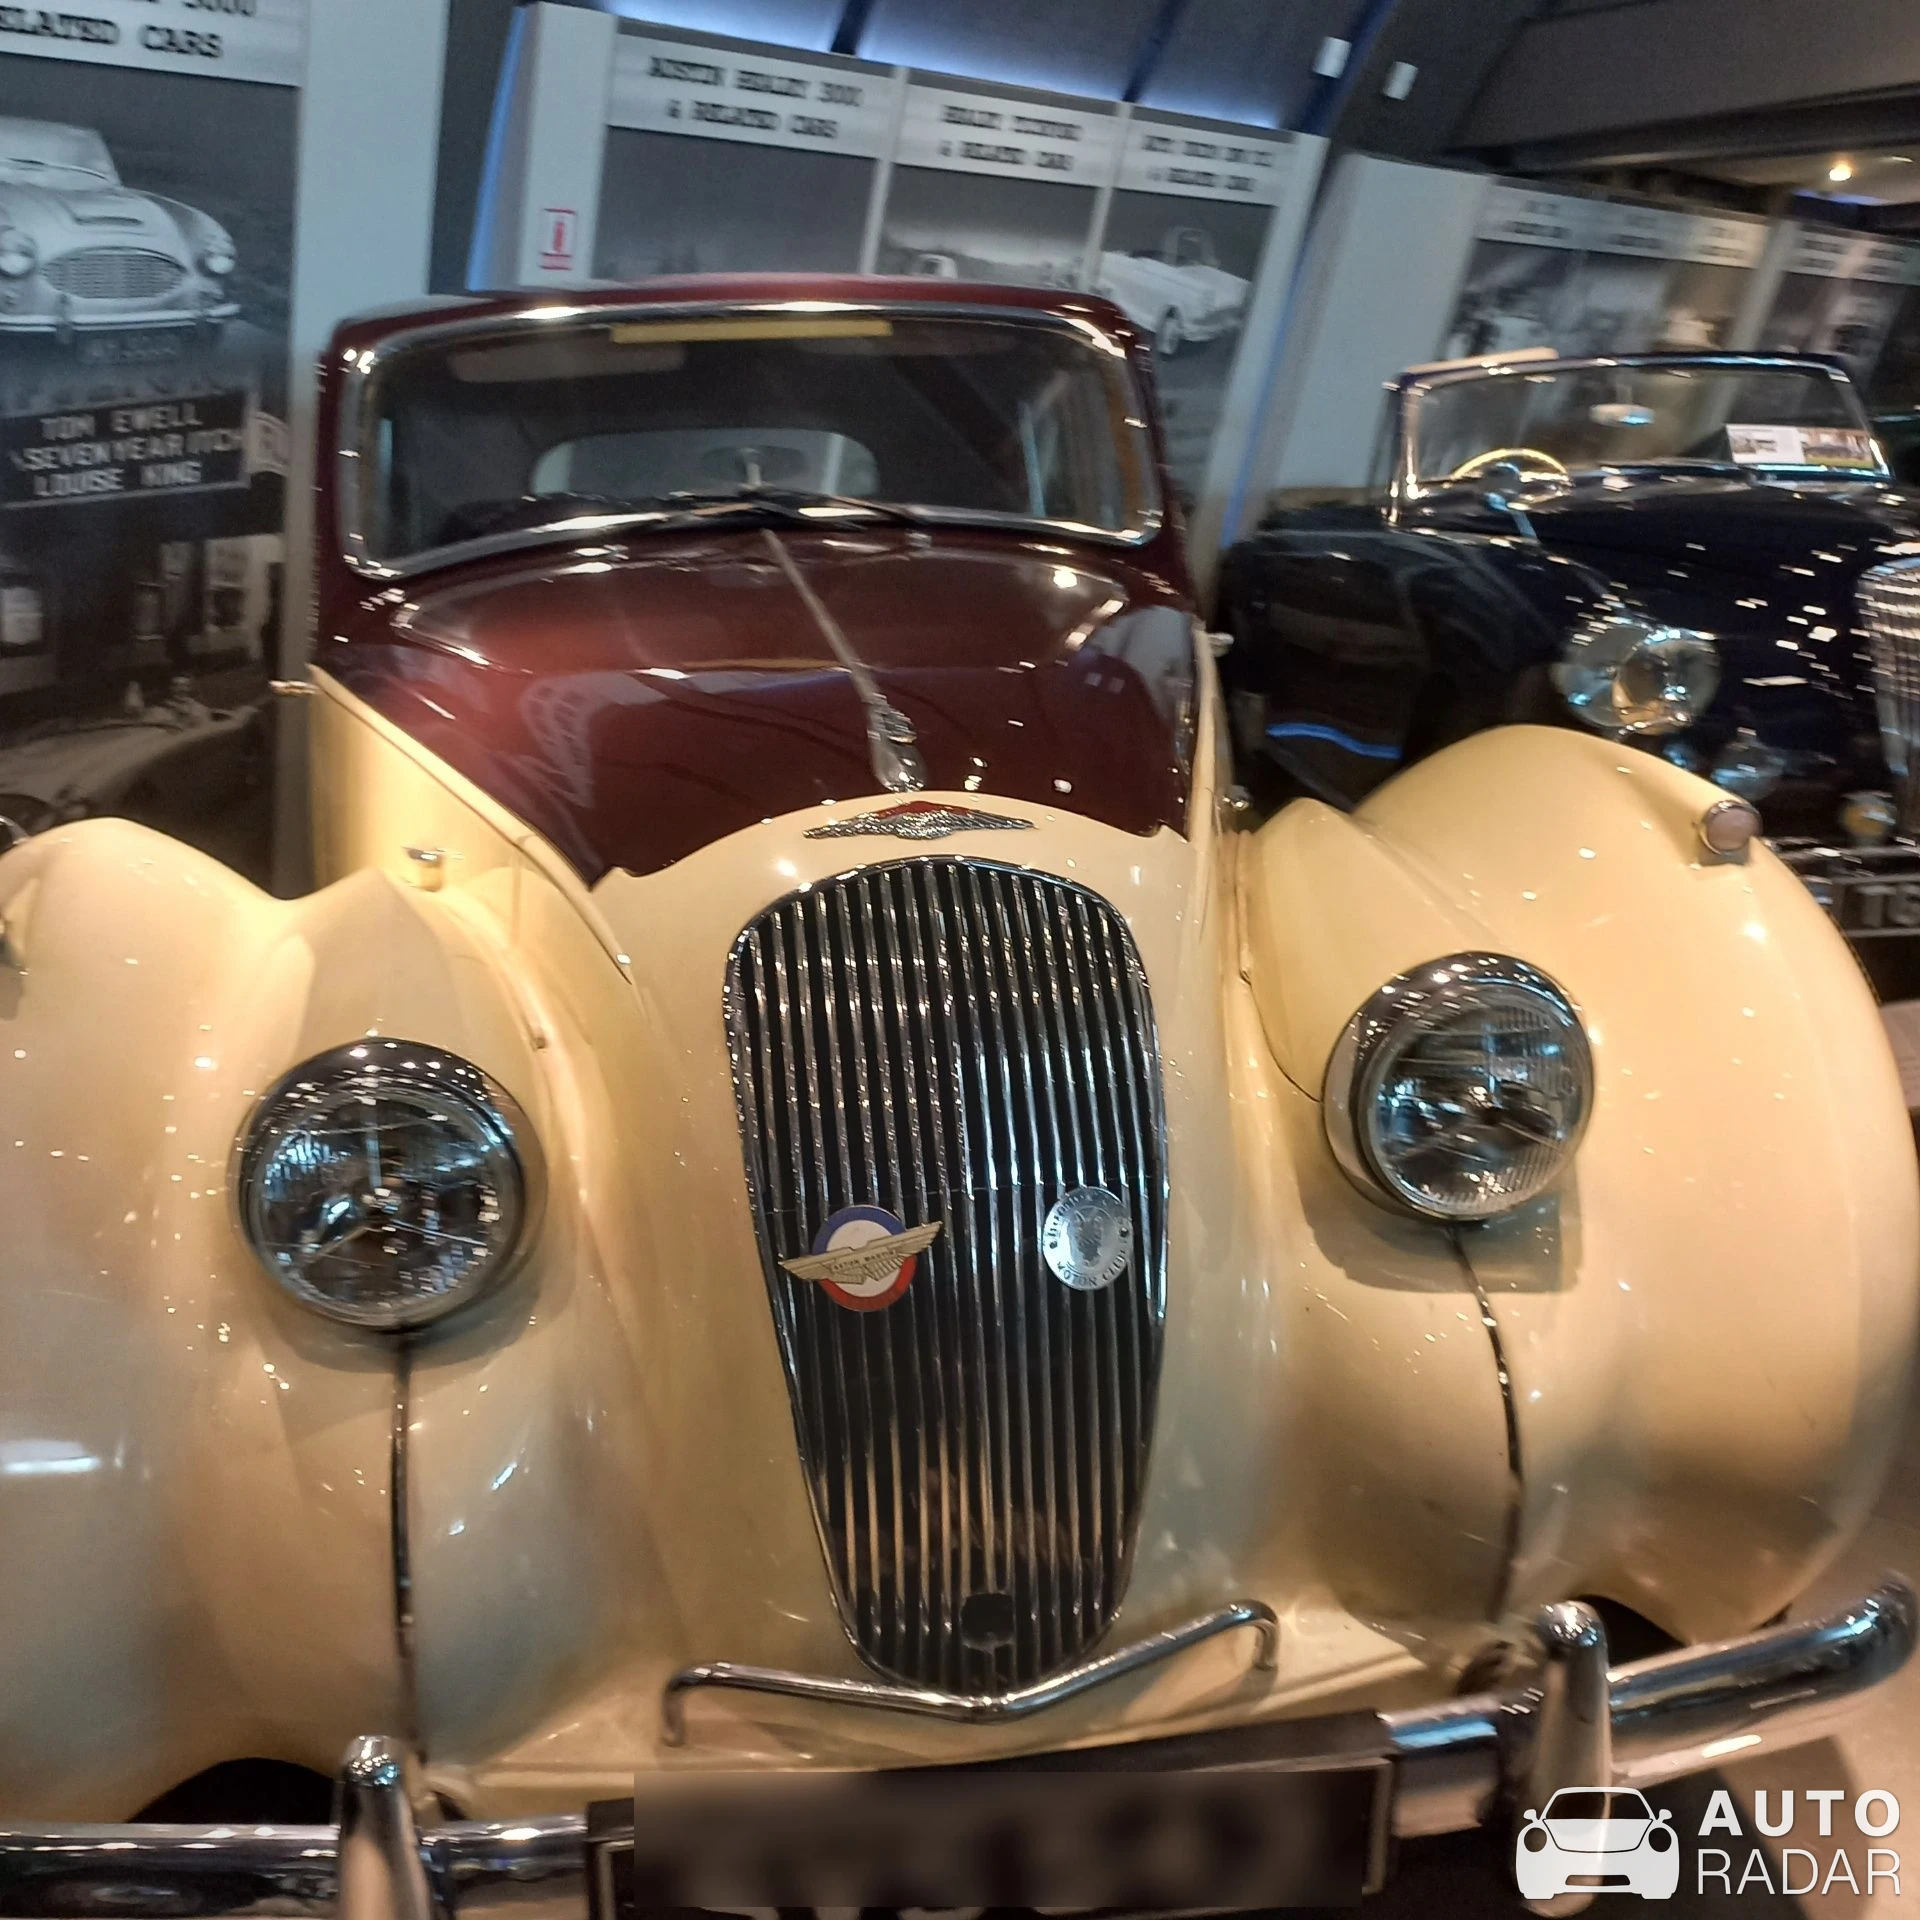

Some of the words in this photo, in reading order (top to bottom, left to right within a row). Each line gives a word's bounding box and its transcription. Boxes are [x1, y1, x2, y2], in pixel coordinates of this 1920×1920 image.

[139, 24, 223, 57] CARS
[111, 402, 203, 433] EWELL
[112, 433, 183, 461] YEAR
